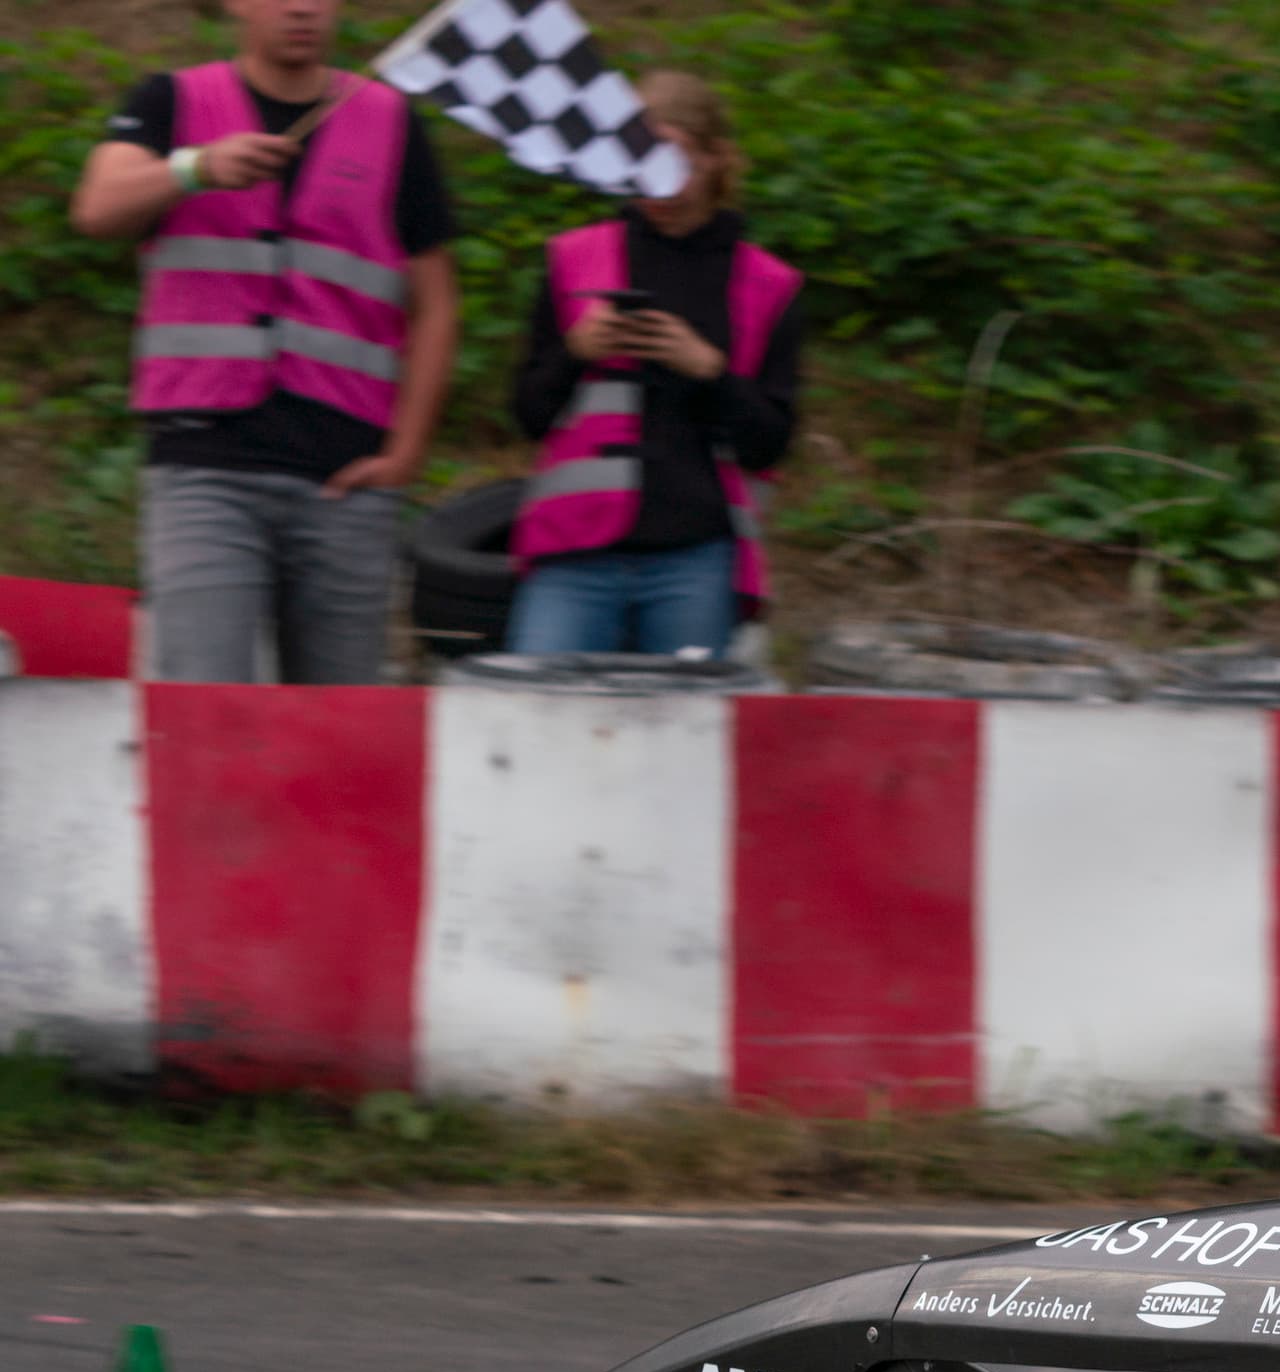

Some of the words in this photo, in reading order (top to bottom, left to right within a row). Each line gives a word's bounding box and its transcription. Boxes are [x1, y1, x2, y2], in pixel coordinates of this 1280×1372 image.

[913, 1291, 978, 1313] Anders
[988, 1276, 1094, 1321] Versichert.
[1139, 1296, 1224, 1314] SCHMALZ
